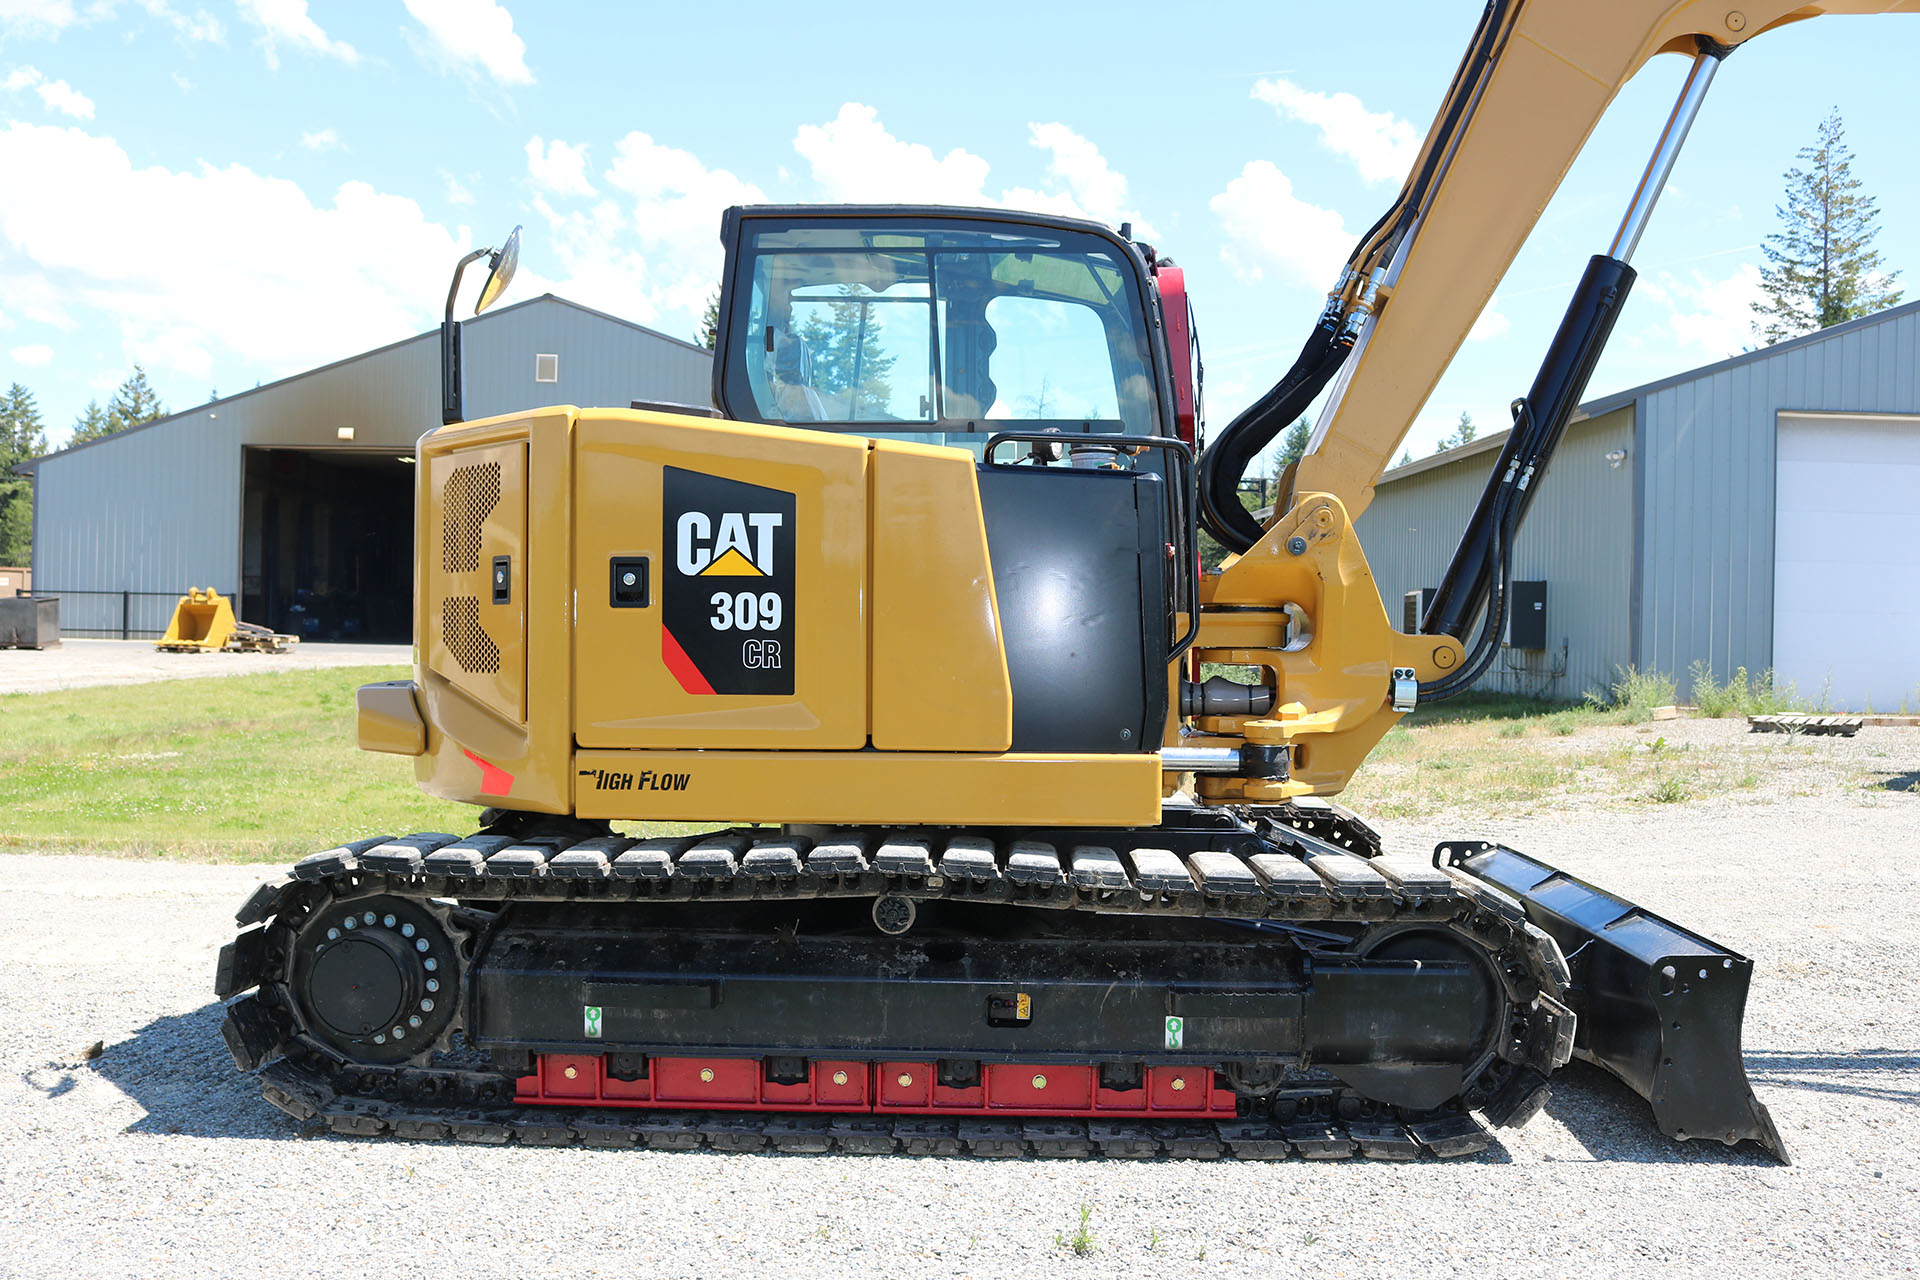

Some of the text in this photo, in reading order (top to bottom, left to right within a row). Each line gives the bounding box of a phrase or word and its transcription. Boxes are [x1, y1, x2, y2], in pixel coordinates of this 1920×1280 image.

[677, 511, 782, 576] CAT
[710, 592, 782, 631] 309
[742, 639, 781, 669] CR
[638, 770, 691, 791] FLOW
